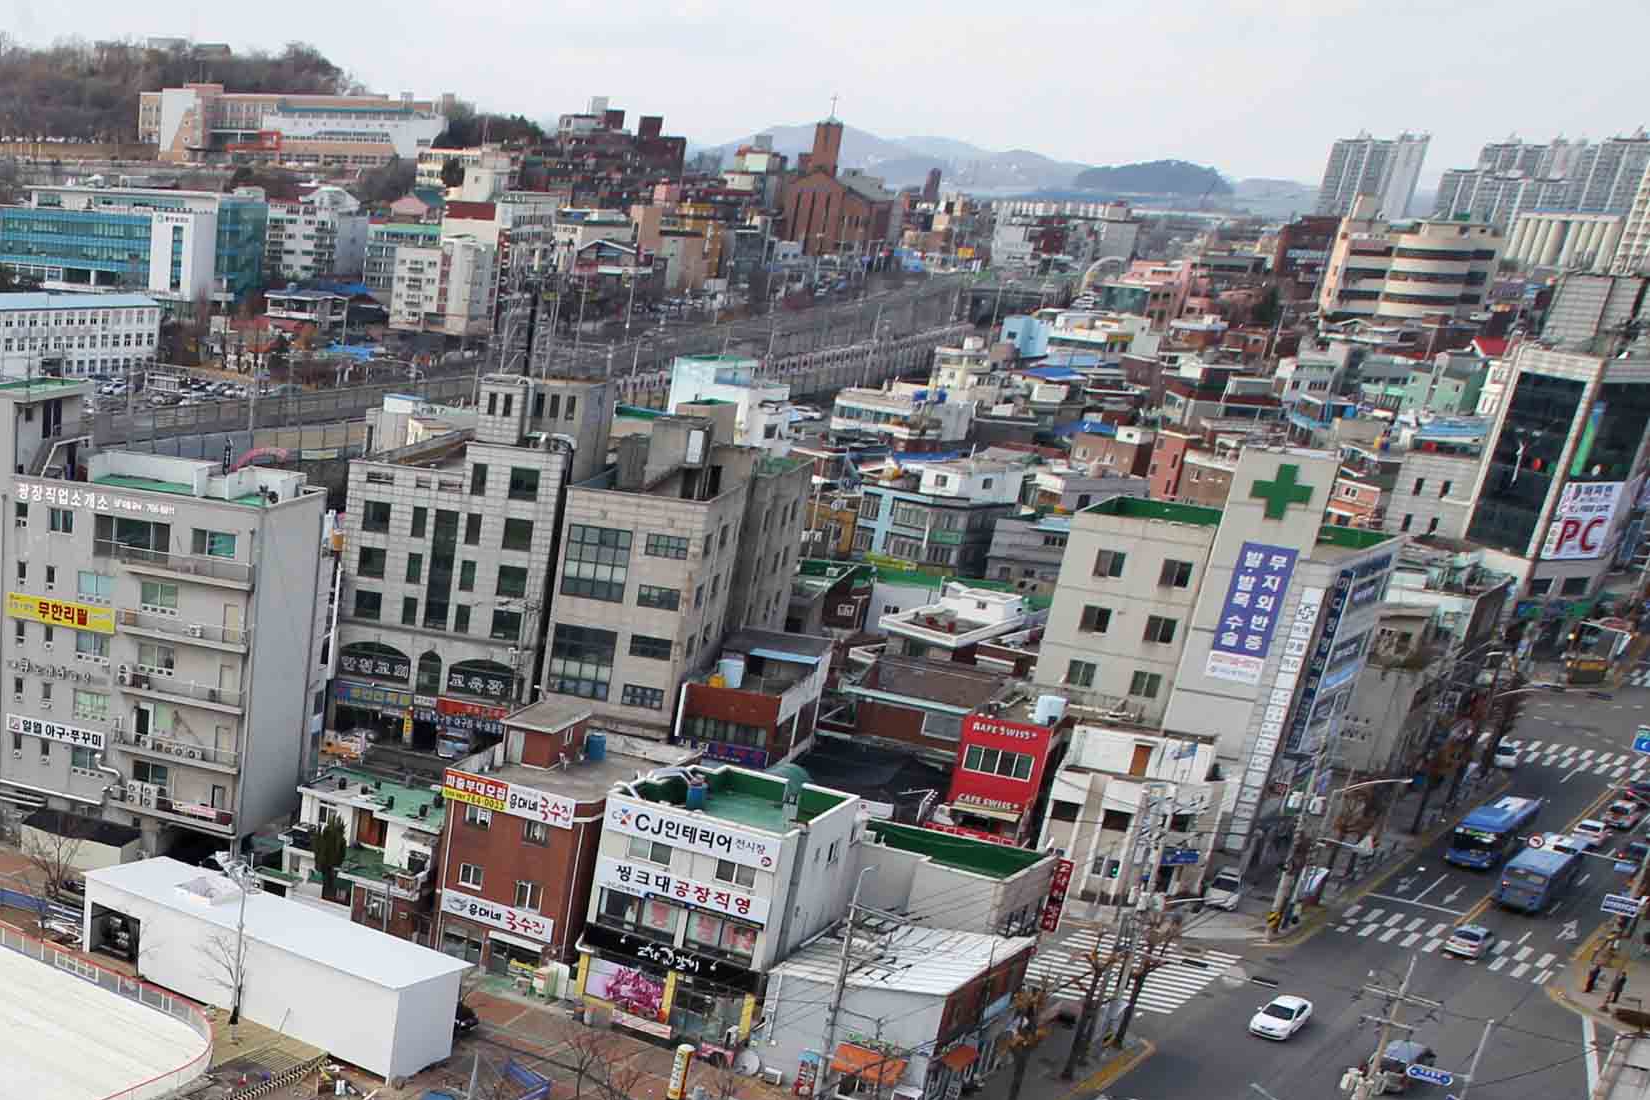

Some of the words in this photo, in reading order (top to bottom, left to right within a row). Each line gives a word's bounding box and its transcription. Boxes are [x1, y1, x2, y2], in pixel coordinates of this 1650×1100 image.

[1553, 516, 1608, 555] PC
[38, 601, 88, 626] 무한리필
[634, 814, 733, 853] CJ인테리어
